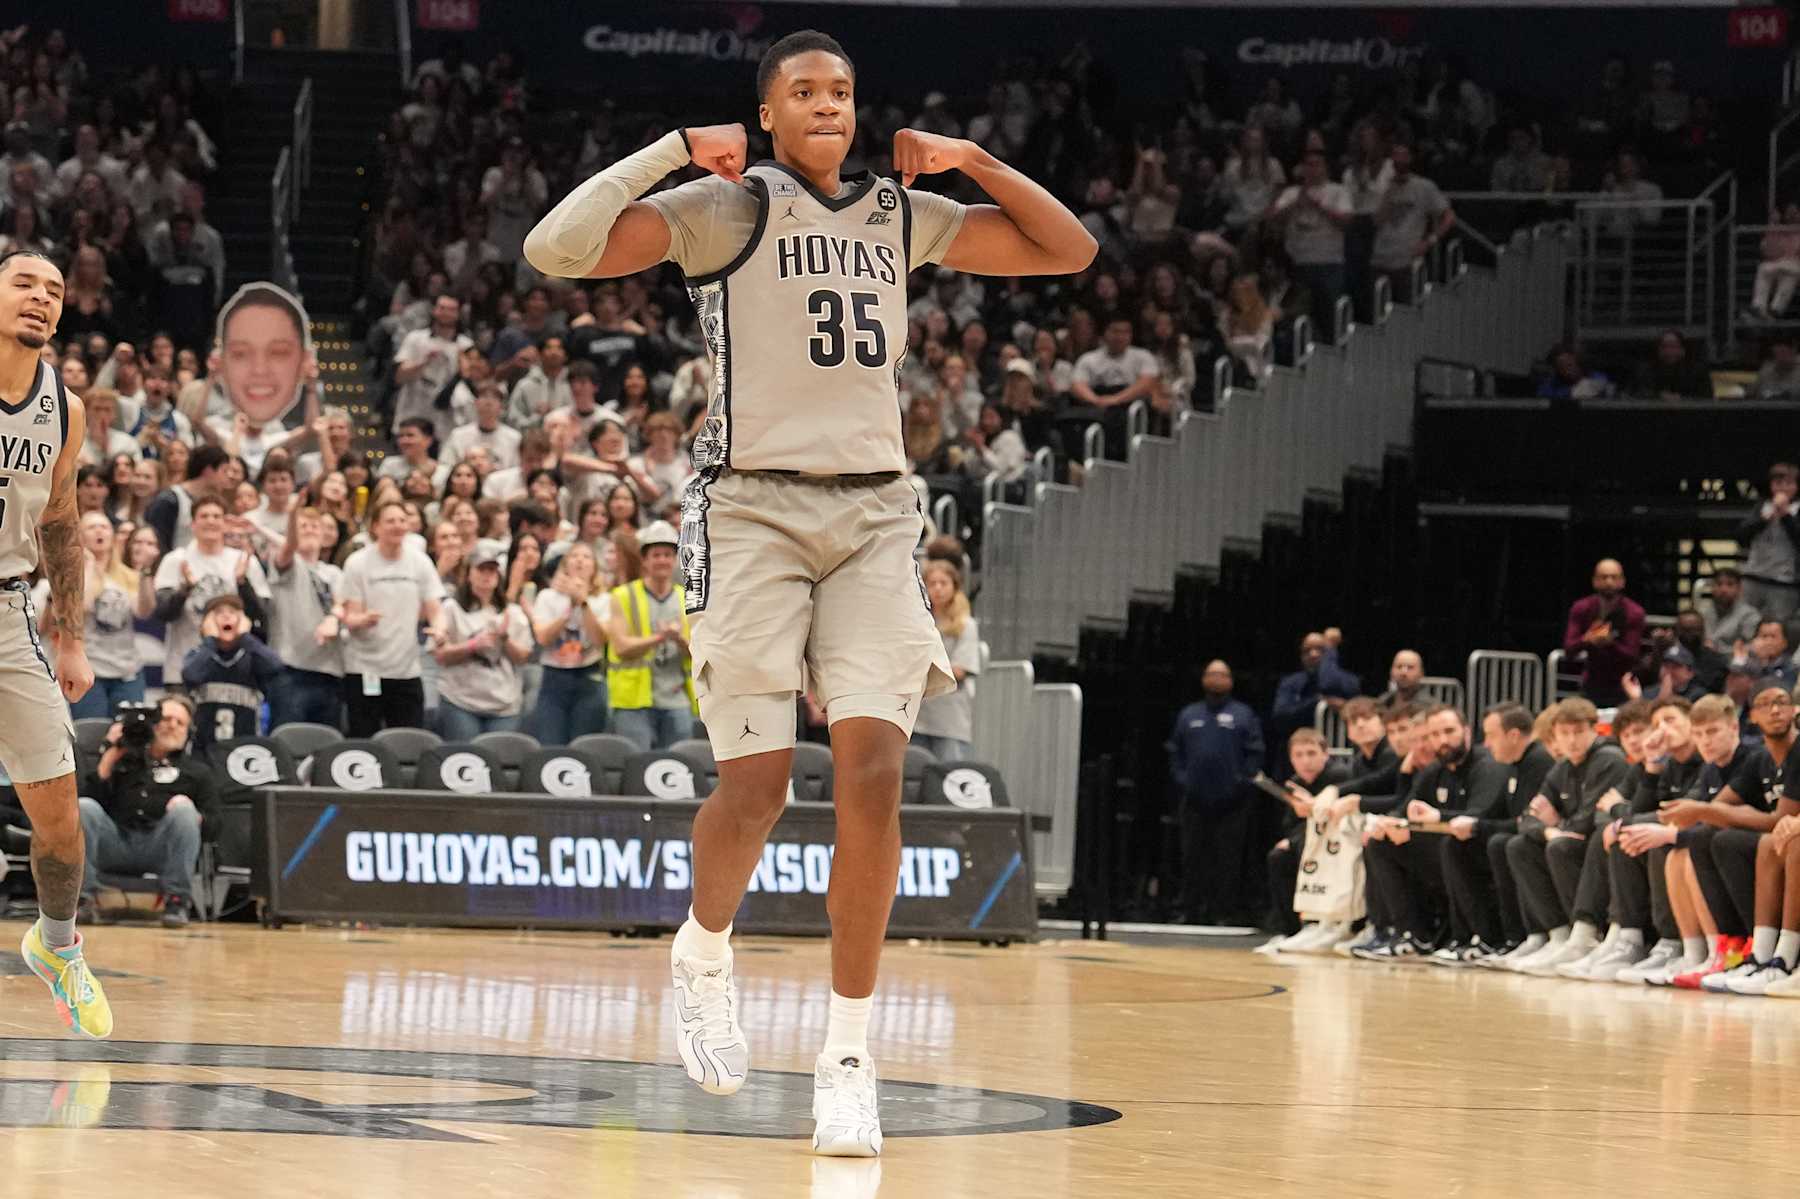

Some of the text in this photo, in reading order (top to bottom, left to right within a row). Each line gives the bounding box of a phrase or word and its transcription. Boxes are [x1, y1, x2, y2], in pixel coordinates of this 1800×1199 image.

[1740, 14, 1777, 40] 104
[777, 233, 896, 287] HOYAS
[806, 287, 888, 369] 35
[227, 744, 280, 785] G
[331, 750, 383, 791] G
[440, 752, 492, 794] G
[541, 757, 592, 798] G
[644, 758, 696, 800] G
[943, 768, 993, 808] G
[346, 829, 961, 898] GUHOYAS.COM/SNSOHIP
